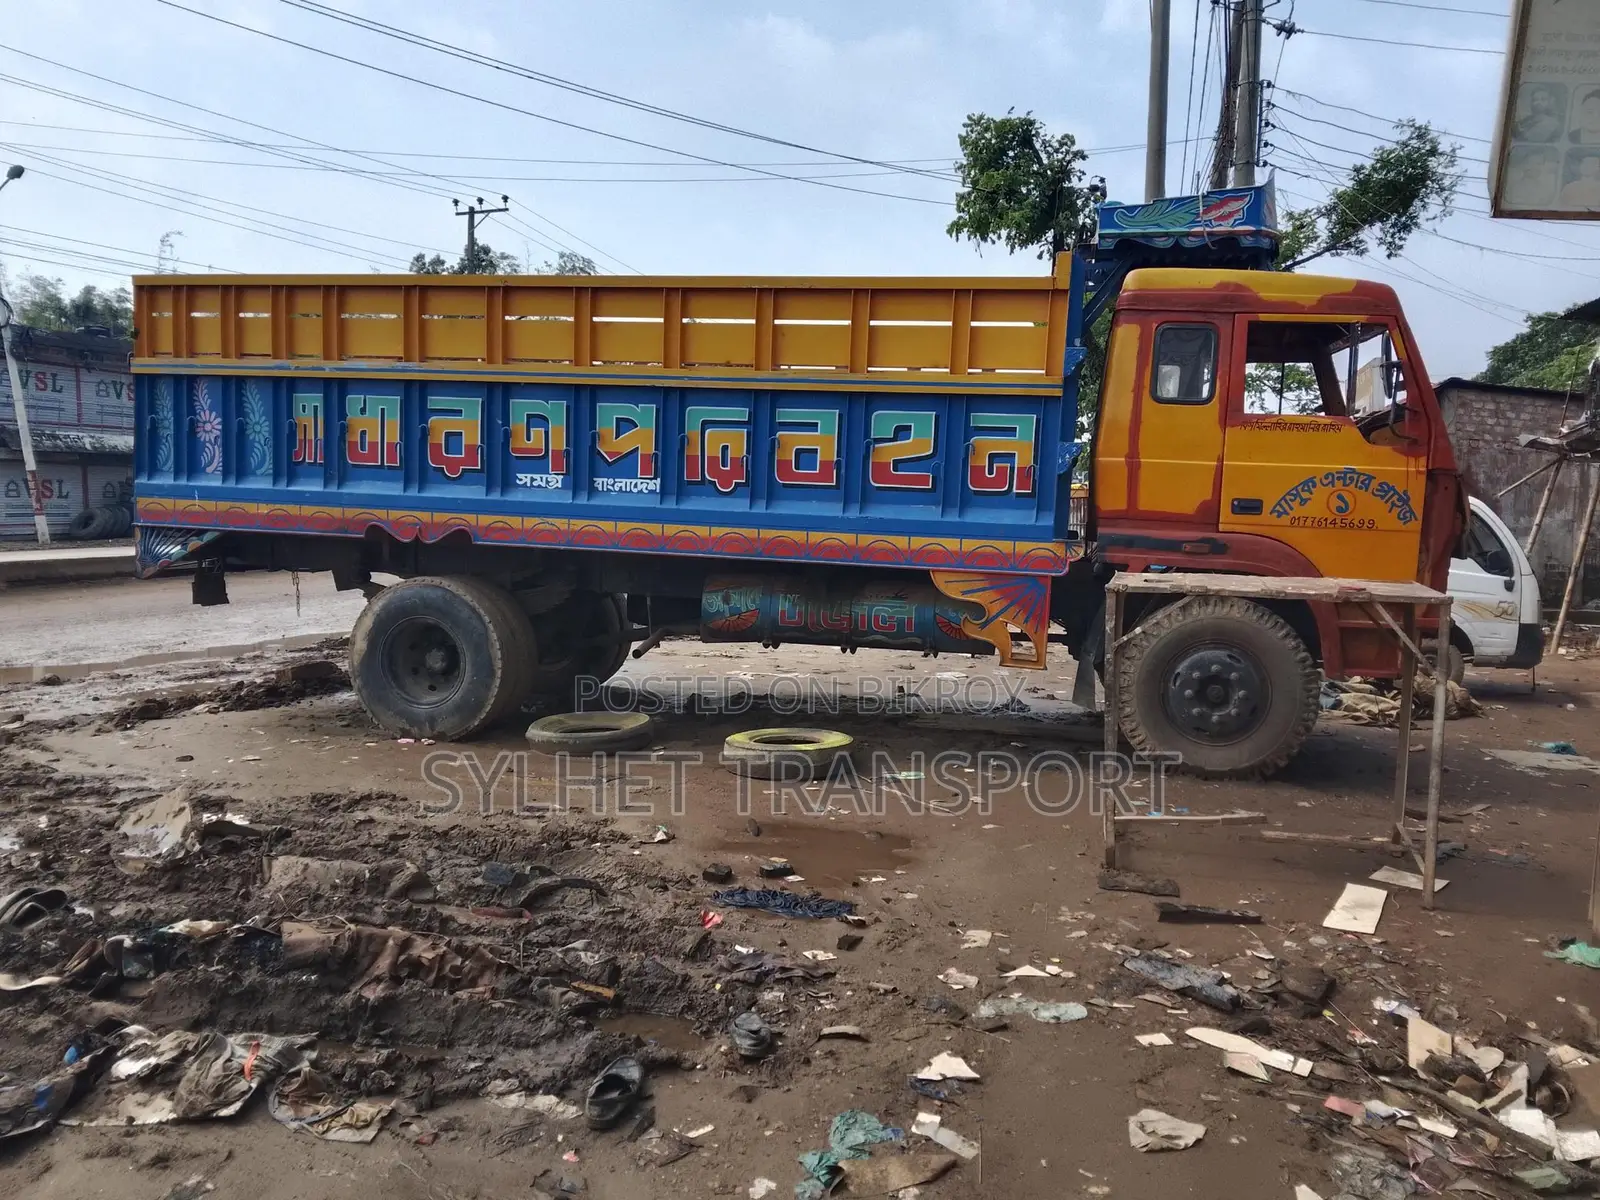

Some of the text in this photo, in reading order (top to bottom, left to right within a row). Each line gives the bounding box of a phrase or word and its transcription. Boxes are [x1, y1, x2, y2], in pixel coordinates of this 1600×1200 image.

[596, 402, 1037, 494] পরিবহন
[515, 473, 661, 494] সমগ্র বাংলাদেশ
[1269, 475, 1317, 518] মাসুক
